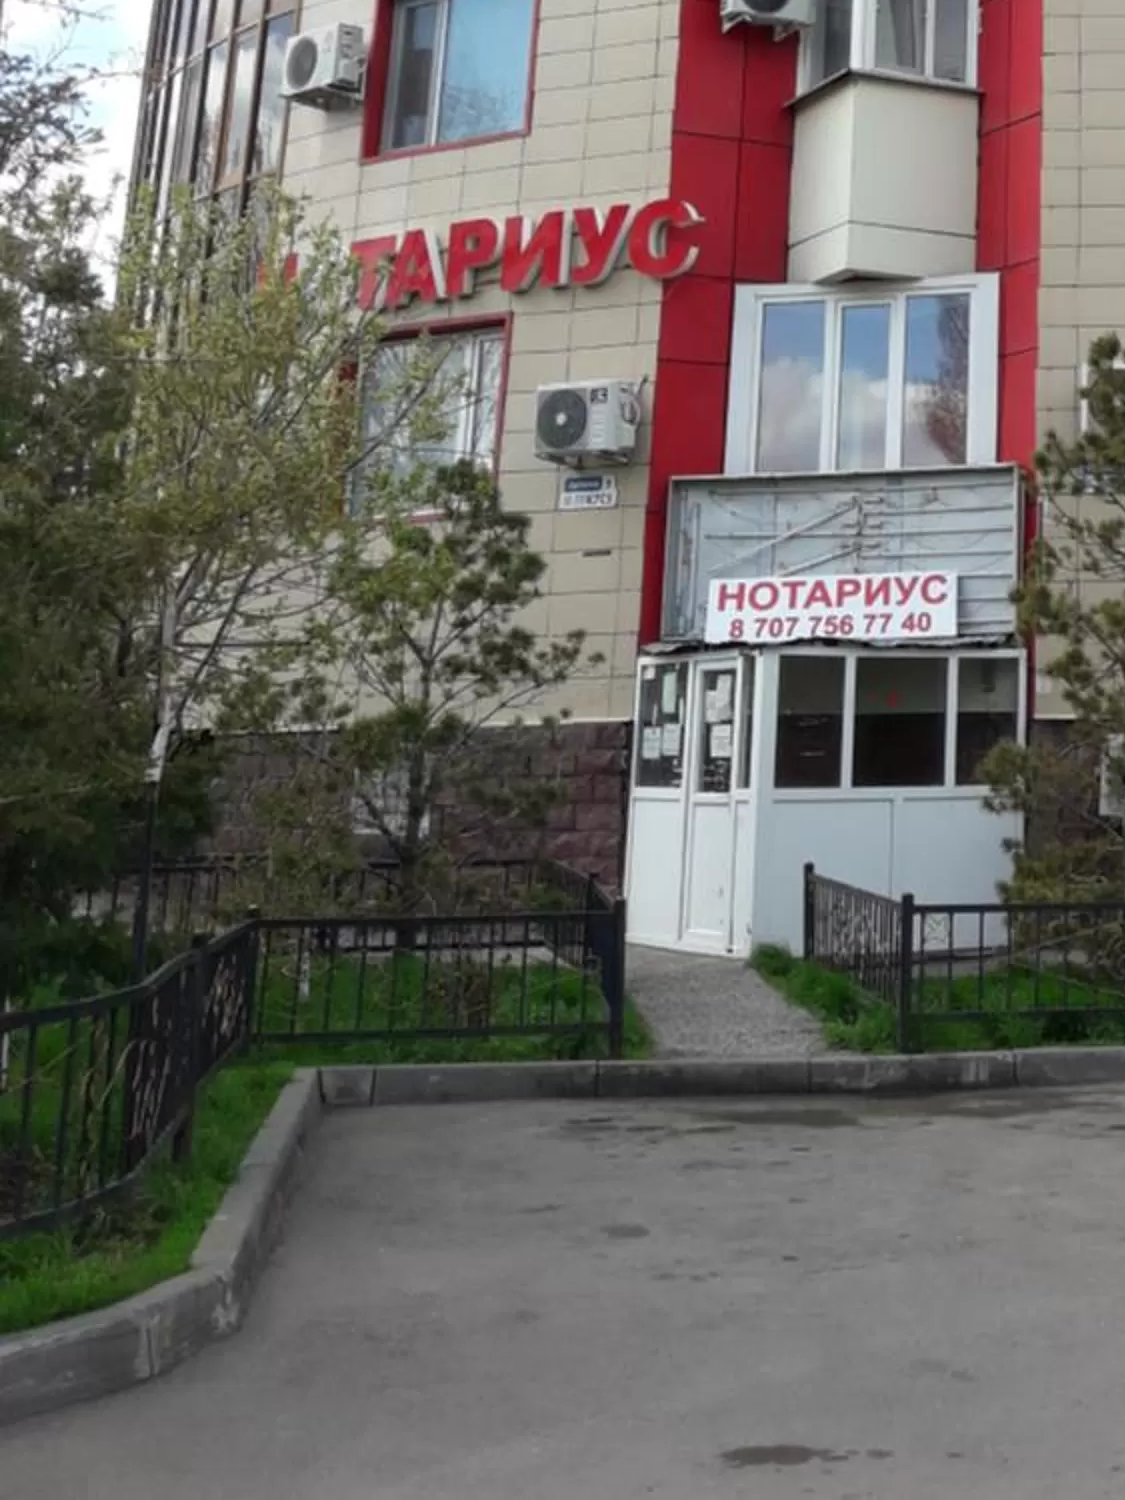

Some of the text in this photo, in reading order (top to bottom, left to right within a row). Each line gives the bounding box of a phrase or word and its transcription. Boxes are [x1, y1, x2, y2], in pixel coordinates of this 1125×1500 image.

[255, 199, 703, 325] ТАРИУС
[717, 573, 947, 612] НОТАРИУС
[729, 612, 931, 639] 8 707 756 77 40
